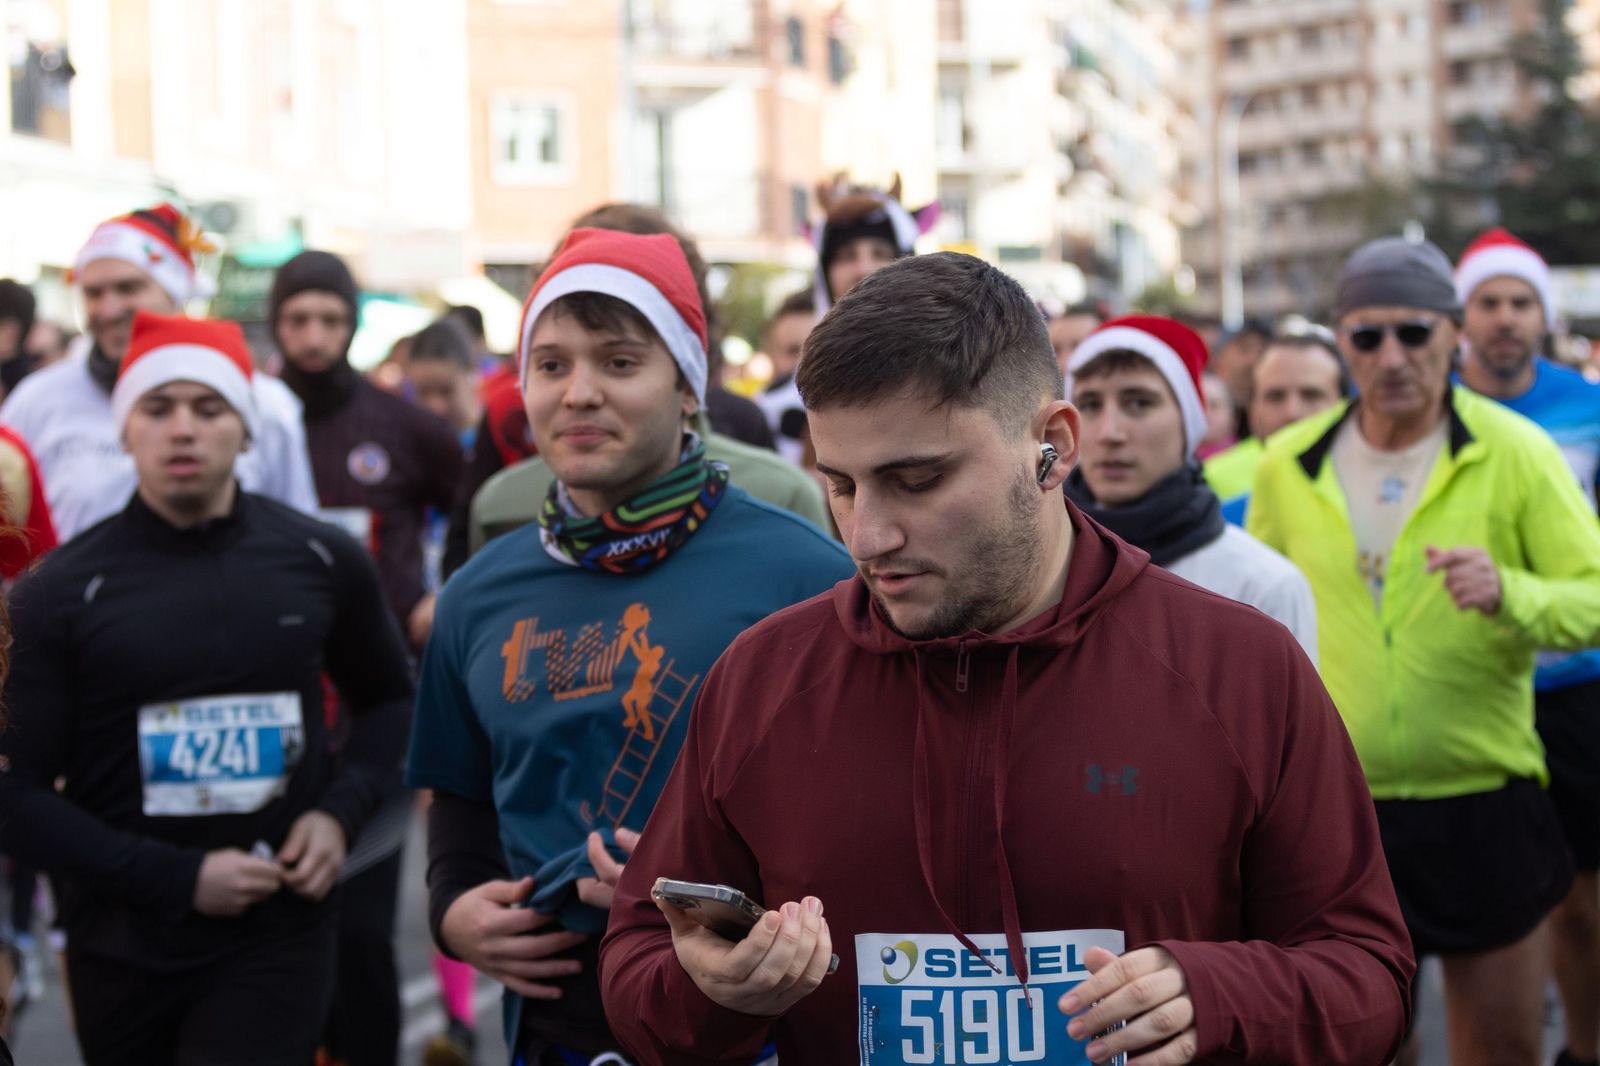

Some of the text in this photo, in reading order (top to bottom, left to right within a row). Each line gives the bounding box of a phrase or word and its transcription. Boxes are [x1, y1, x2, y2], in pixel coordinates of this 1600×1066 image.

[168, 726, 260, 778] 4241
[924, 943, 1088, 978] SETEL
[900, 987, 1046, 1064] 5190
